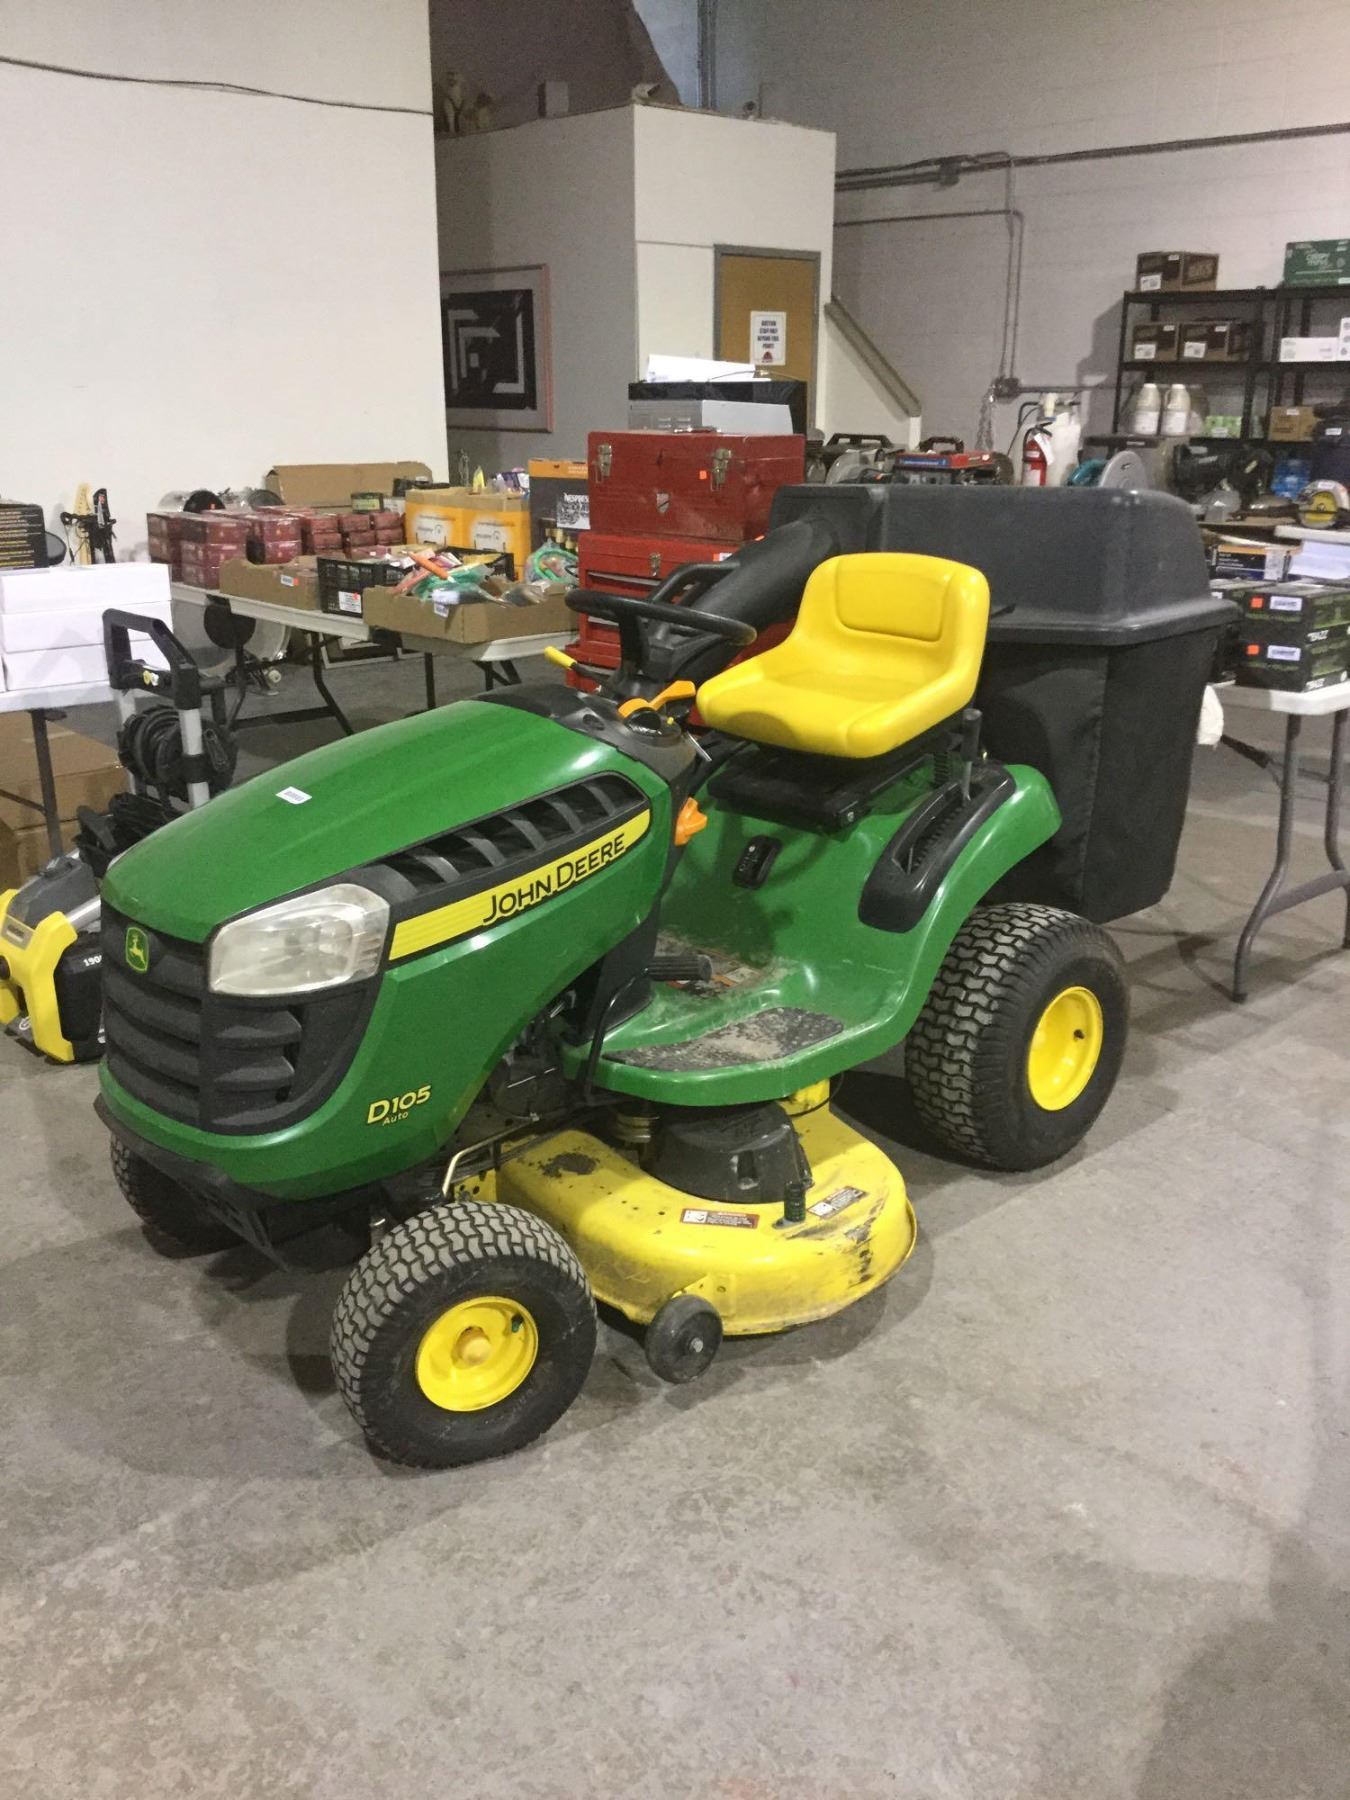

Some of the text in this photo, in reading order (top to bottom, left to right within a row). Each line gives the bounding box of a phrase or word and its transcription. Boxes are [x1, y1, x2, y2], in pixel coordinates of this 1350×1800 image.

[483, 832, 626, 923] JOHN DEERE
[367, 1085, 432, 1124] D105
